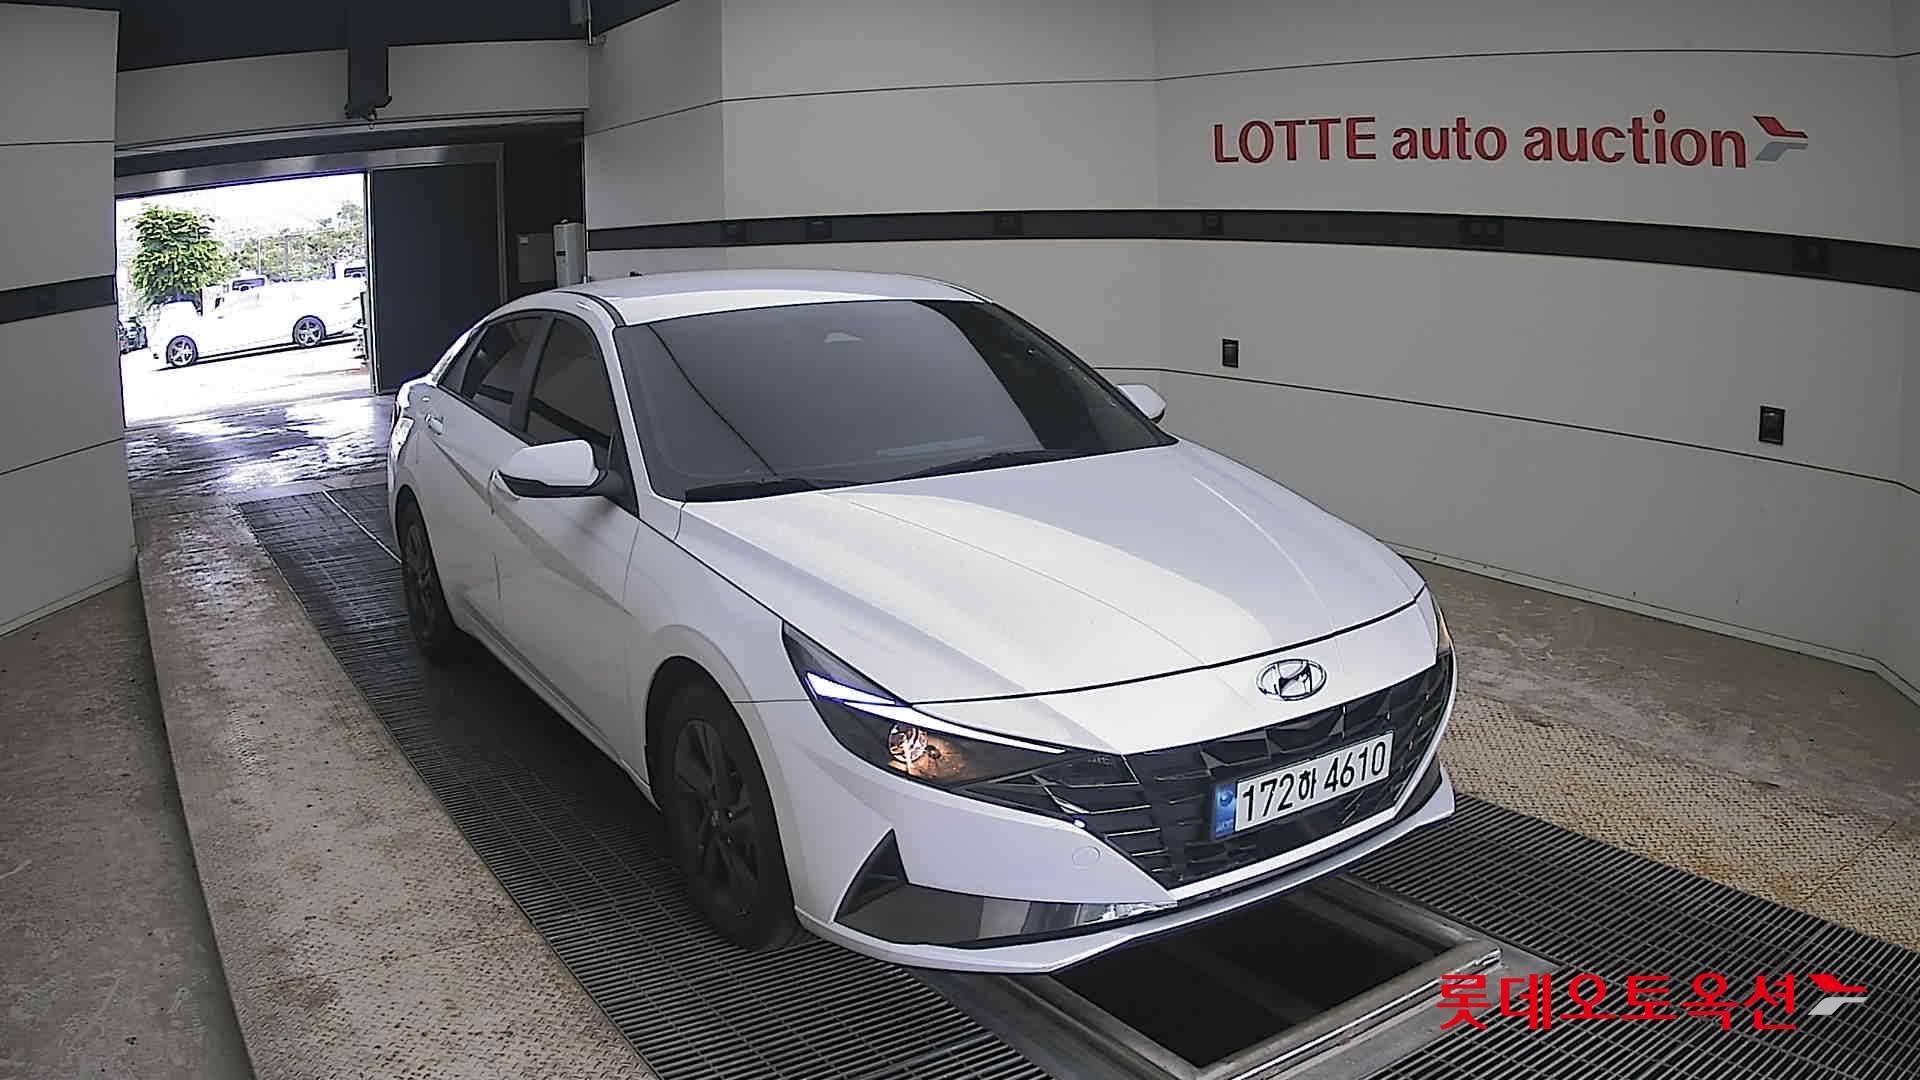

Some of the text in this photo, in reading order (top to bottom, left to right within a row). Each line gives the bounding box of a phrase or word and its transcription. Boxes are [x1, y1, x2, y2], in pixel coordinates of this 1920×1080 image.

[1213, 109, 1747, 168] LOTTE auto auction
[1242, 741, 1386, 822] 172하 4610
